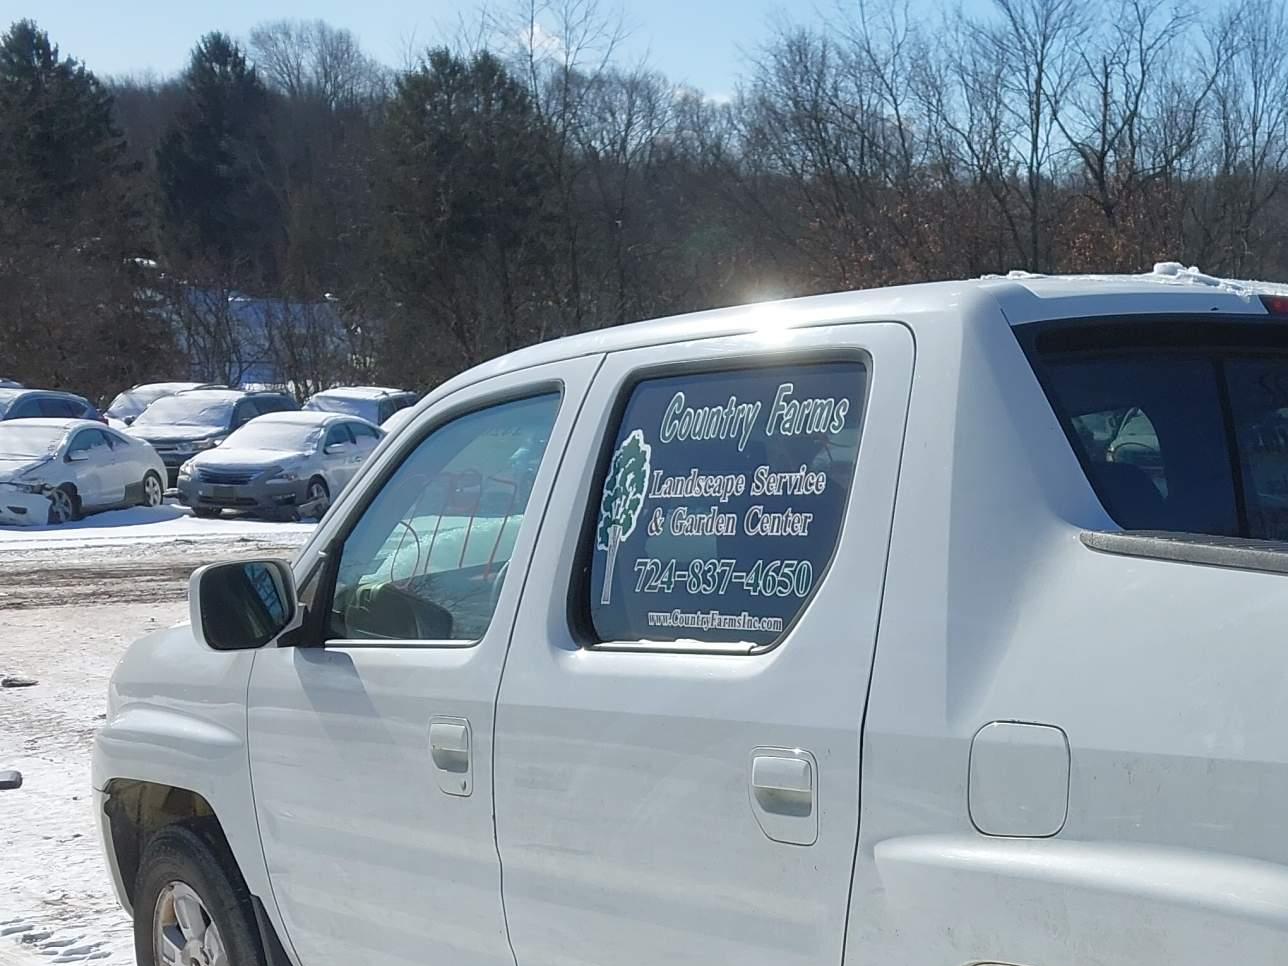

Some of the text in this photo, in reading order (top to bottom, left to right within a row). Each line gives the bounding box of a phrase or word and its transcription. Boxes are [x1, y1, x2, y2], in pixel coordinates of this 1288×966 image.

[660, 383, 849, 451] Country Farms
[649, 464, 826, 502] Landscape Service
[648, 505, 813, 536] & Garden Center
[634, 559, 813, 597] 724-837-4650
[648, 610, 783, 632] www.CountryFarmsInc.com
